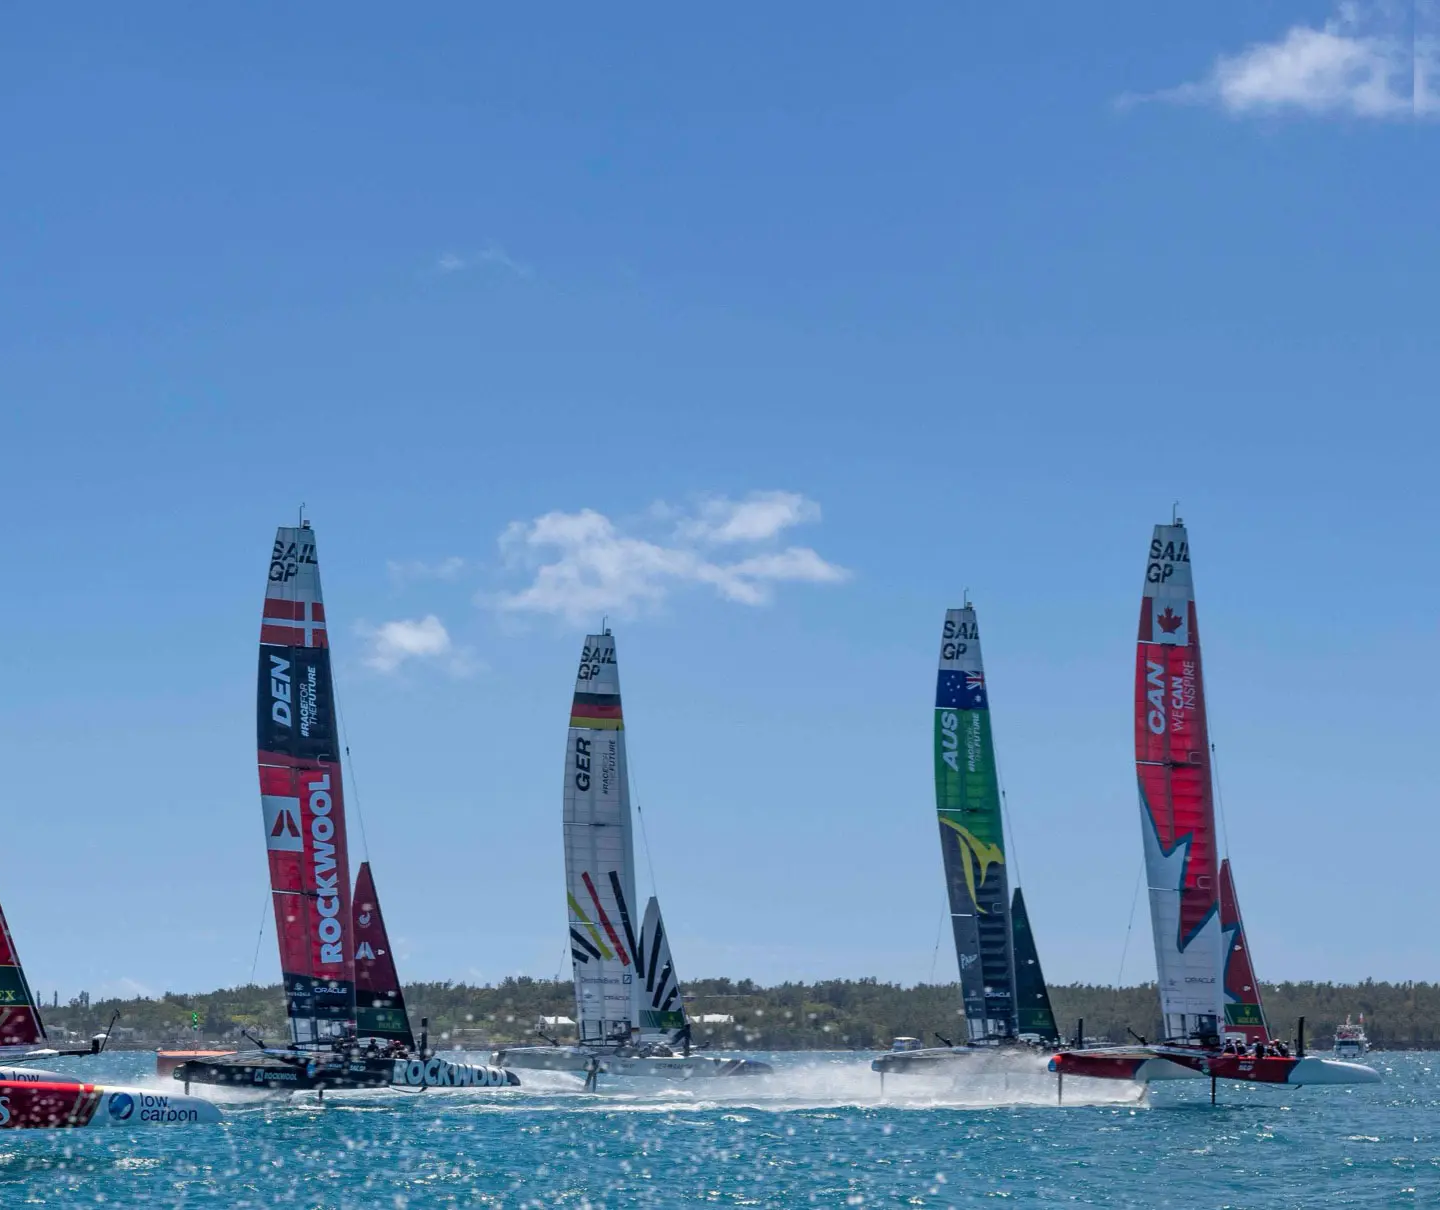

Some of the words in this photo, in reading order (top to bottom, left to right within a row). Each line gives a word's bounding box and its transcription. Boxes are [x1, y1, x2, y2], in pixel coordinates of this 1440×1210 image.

[271, 540, 318, 564] SAIL
[1149, 539, 1190, 563] SAIL
[268, 561, 298, 582] GP
[1147, 563, 1174, 584] GP
[943, 620, 980, 640] SAIL
[580, 646, 617, 665] SAIL
[942, 642, 968, 661] GP
[577, 664, 600, 680] GP
[270, 655, 293, 728] DEN
[1183, 661, 1195, 710] INSPIRE
[1146, 660, 1166, 735] CAN
[941, 711, 959, 772] AUS
[575, 737, 591, 792] GER
[308, 773, 343, 964] ROCKWOOL
[13, 1071, 40, 1082] low
[264, 1072, 297, 1081] ROCKWOOL
[393, 1058, 513, 1087] ROCKWOOL
[140, 1091, 168, 1107] low
[140, 1106, 198, 1122] carbon
